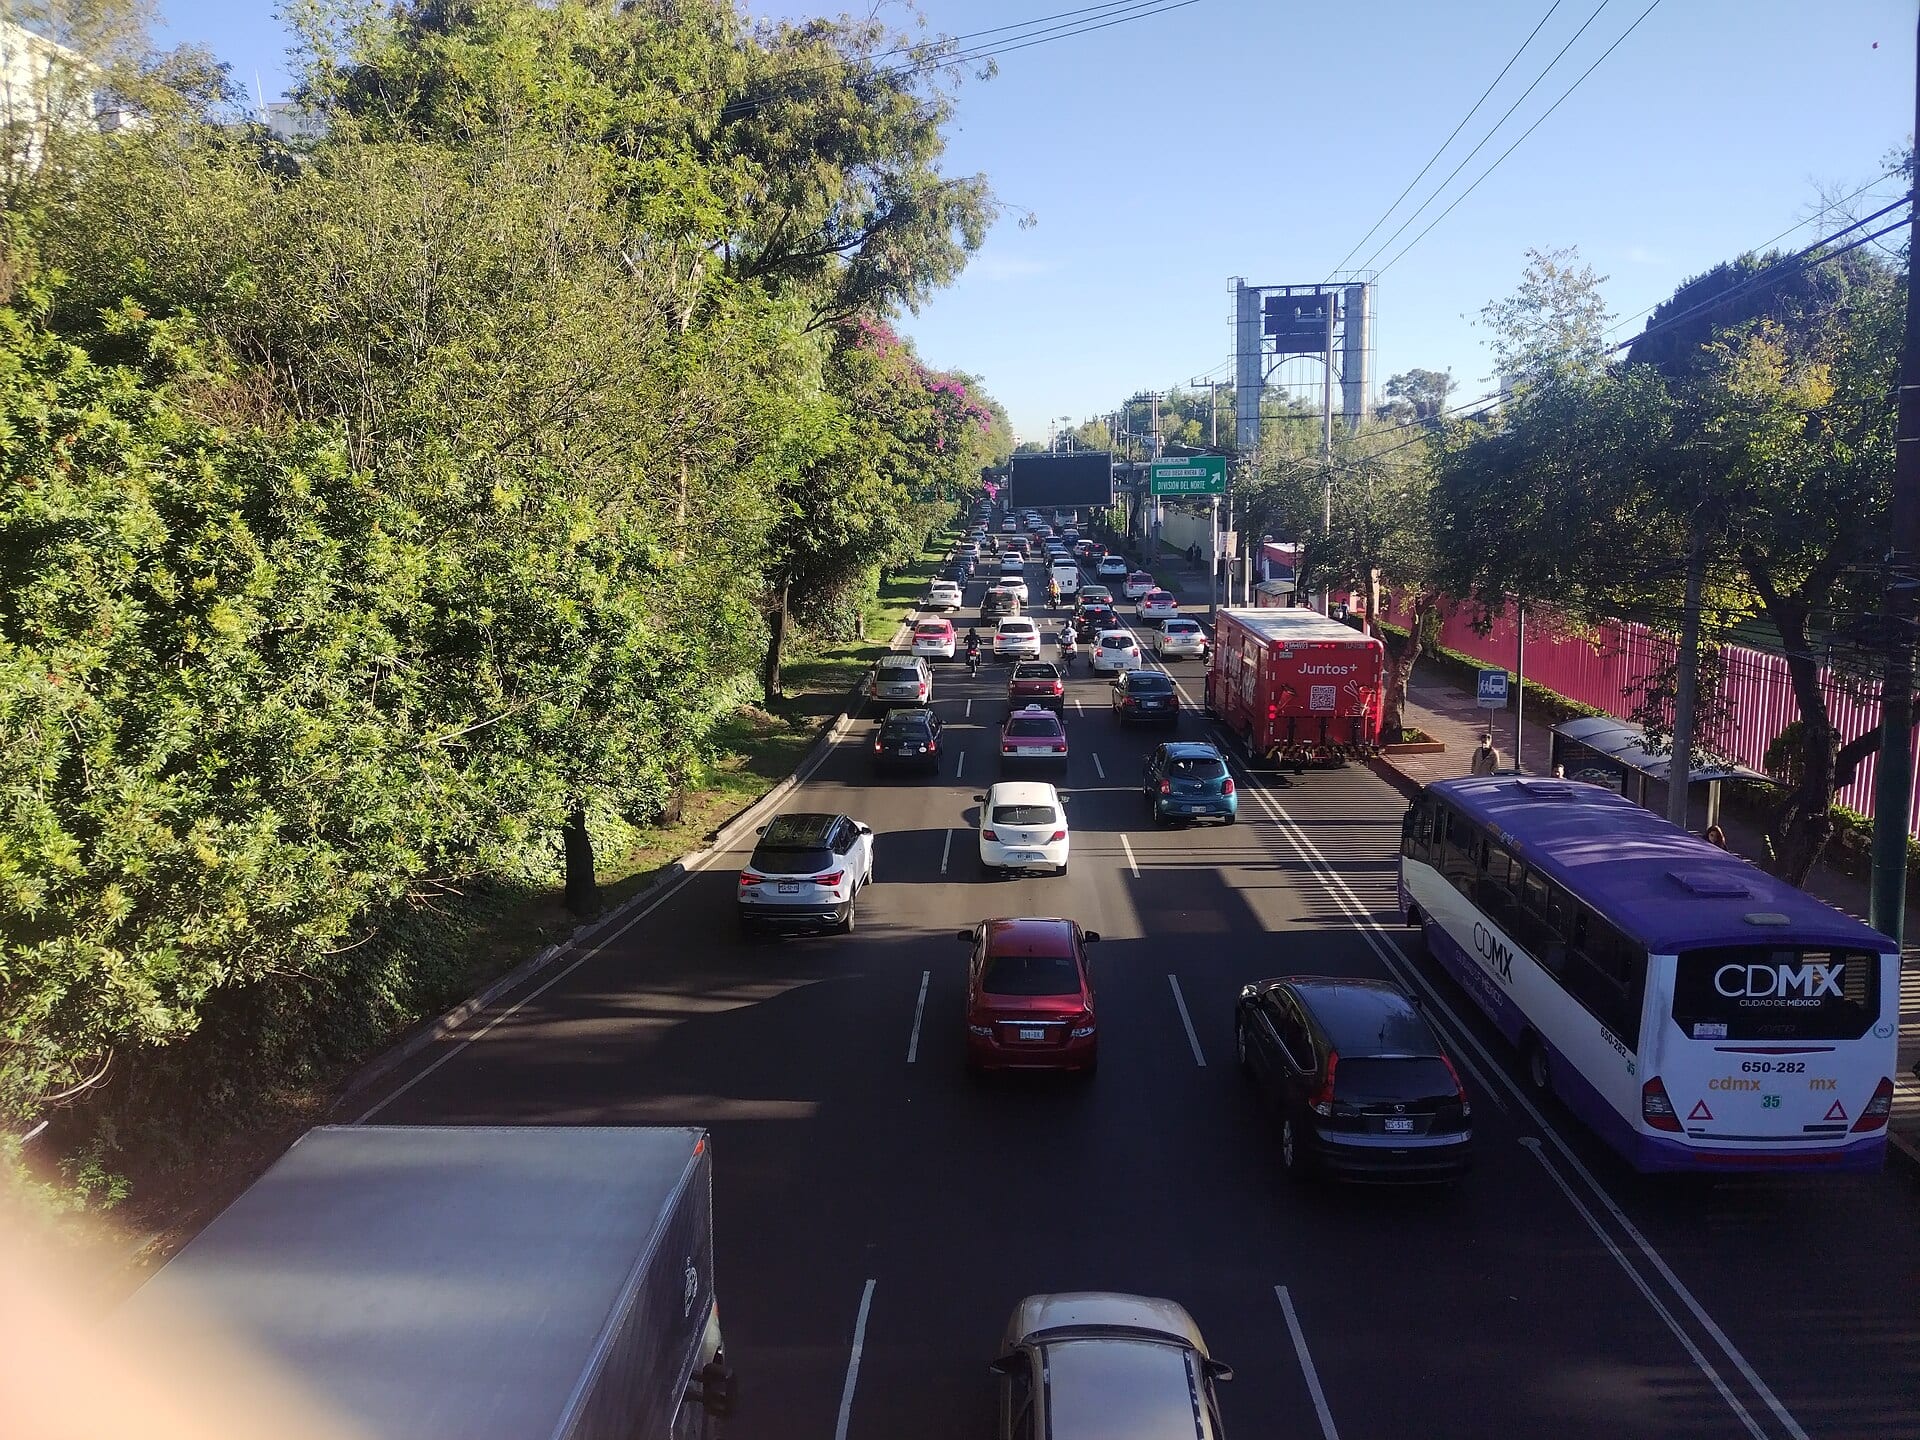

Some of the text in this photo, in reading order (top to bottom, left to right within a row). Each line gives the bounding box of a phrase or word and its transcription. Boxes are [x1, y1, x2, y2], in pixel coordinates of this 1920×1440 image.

[1180, 481, 1190, 490] DEL
[1190, 481, 1206, 490] NORTE
[1474, 922, 1513, 984] CDMX
[1714, 964, 1845, 997] CDMX
[1739, 999, 1773, 1007] CIUDAD
[1773, 999, 1787, 1007] DE
[1600, 1026, 1627, 1058] 650-282
[1741, 1061, 1806, 1073] 650-282
[1708, 1076, 1761, 1091] cdmx
[1808, 1078, 1838, 1091] mx
[1762, 1095, 1780, 1108] 35
